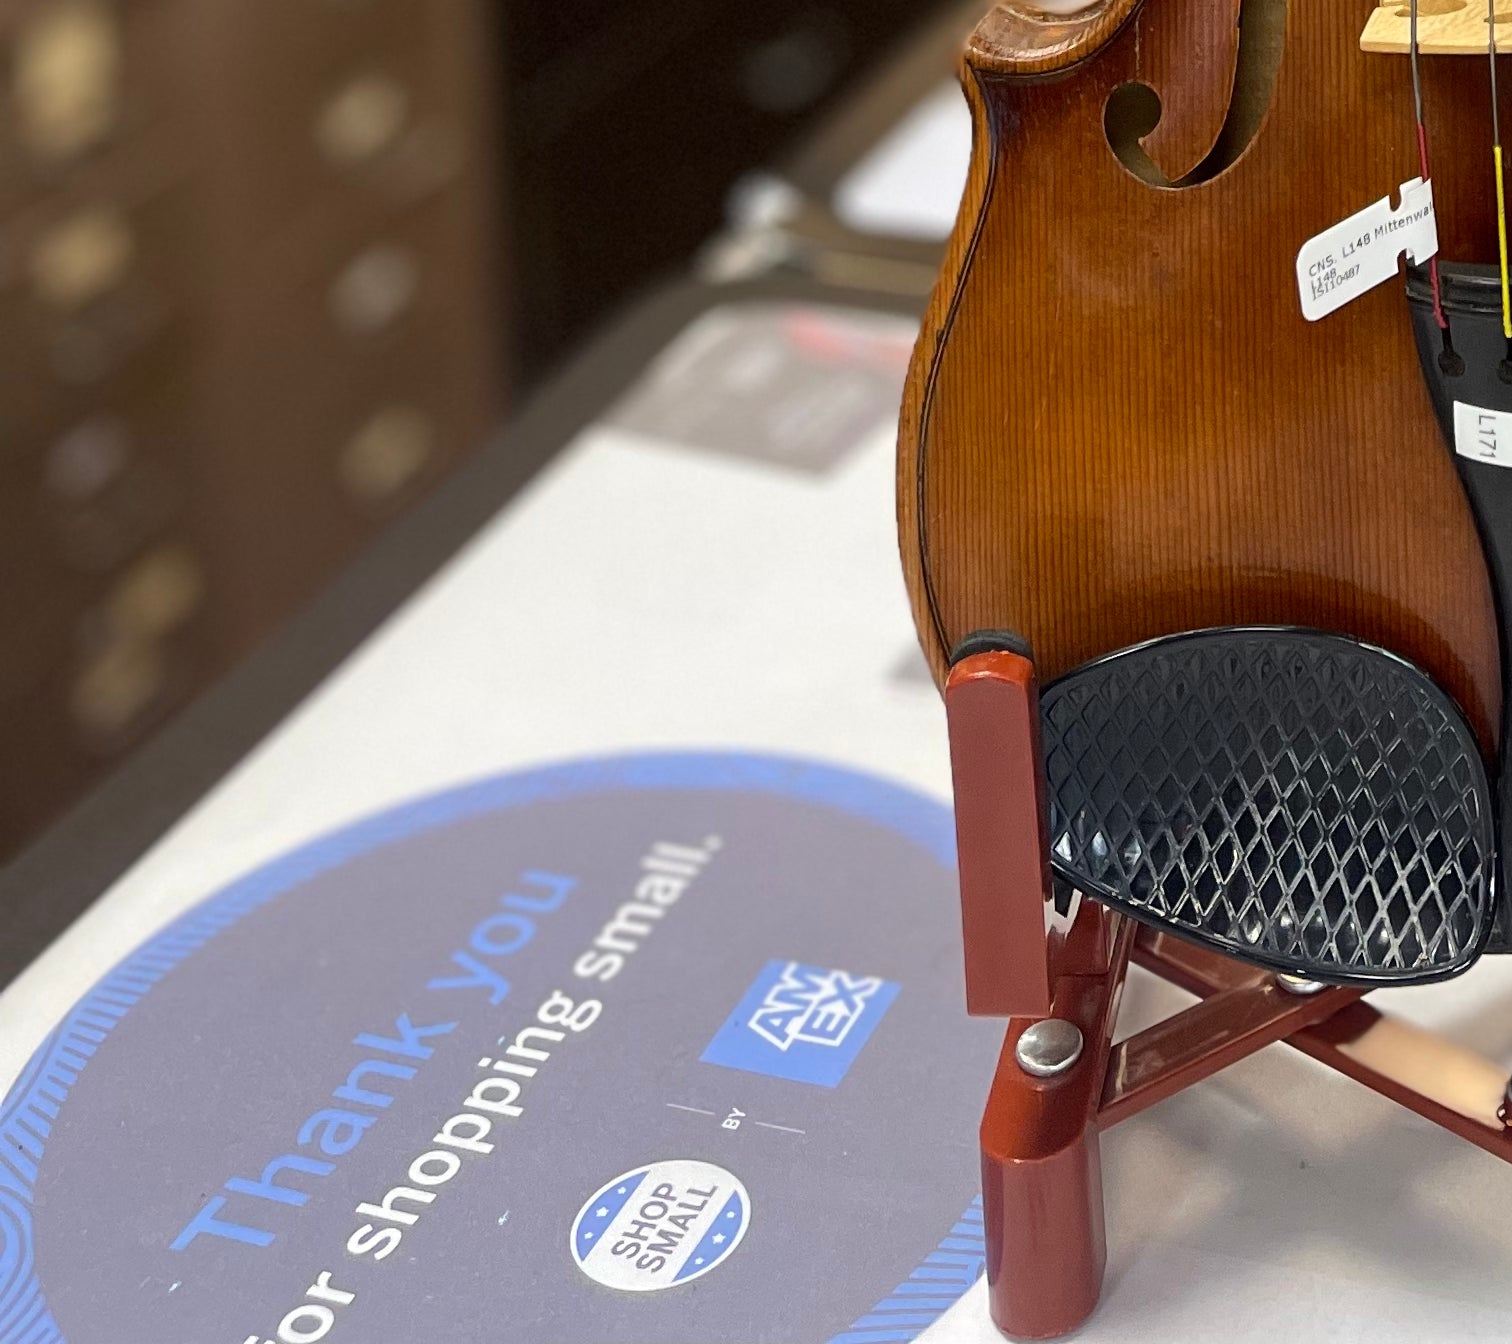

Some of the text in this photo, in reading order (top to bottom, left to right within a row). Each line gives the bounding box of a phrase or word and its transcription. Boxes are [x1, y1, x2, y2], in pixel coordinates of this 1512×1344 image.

[1309, 254, 1337, 277] CNS.
[1342, 233, 1371, 258] L148
[1478, 414, 1497, 459] L171
[169, 870, 578, 1250] Thank you
[347, 990, 602, 1259] shopping
[573, 835, 722, 981] small.
[721, 1107, 746, 1130] BY
[610, 1182, 678, 1260] SHOP
[635, 1185, 719, 1273] SMALL
